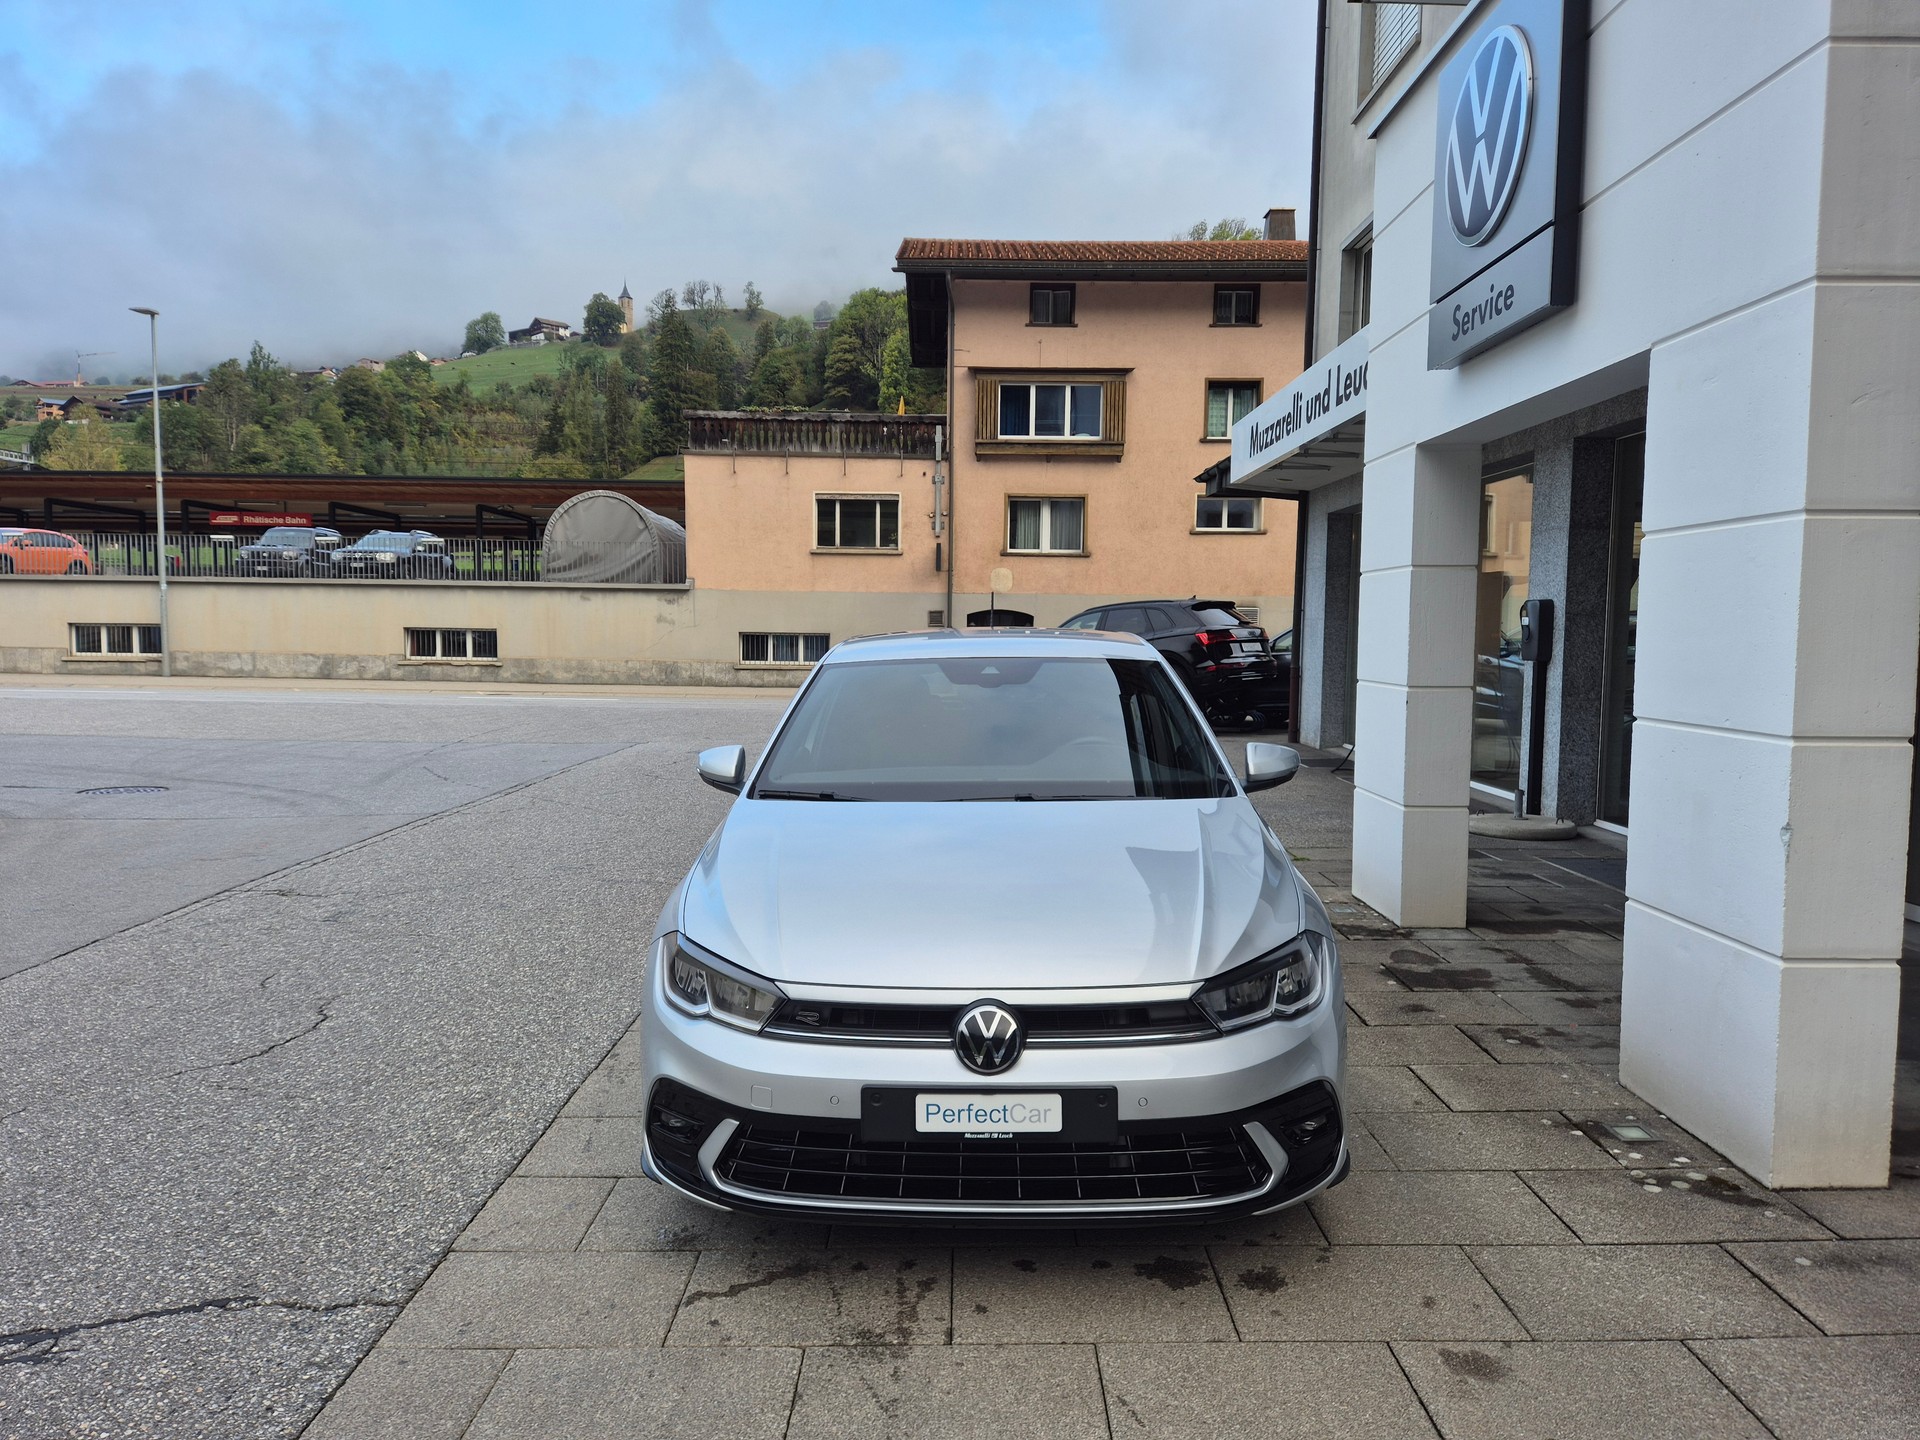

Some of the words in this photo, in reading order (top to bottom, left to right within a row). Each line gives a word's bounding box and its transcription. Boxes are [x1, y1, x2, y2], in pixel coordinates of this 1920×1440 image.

[1451, 283, 1515, 342] Service
[1249, 391, 1303, 459] Muzzarelli
[1305, 368, 1332, 424] und
[243, 515, 284, 524] Rhätische
[285, 516, 307, 525] Bahn
[925, 1103, 1052, 1124] PerfectCar
